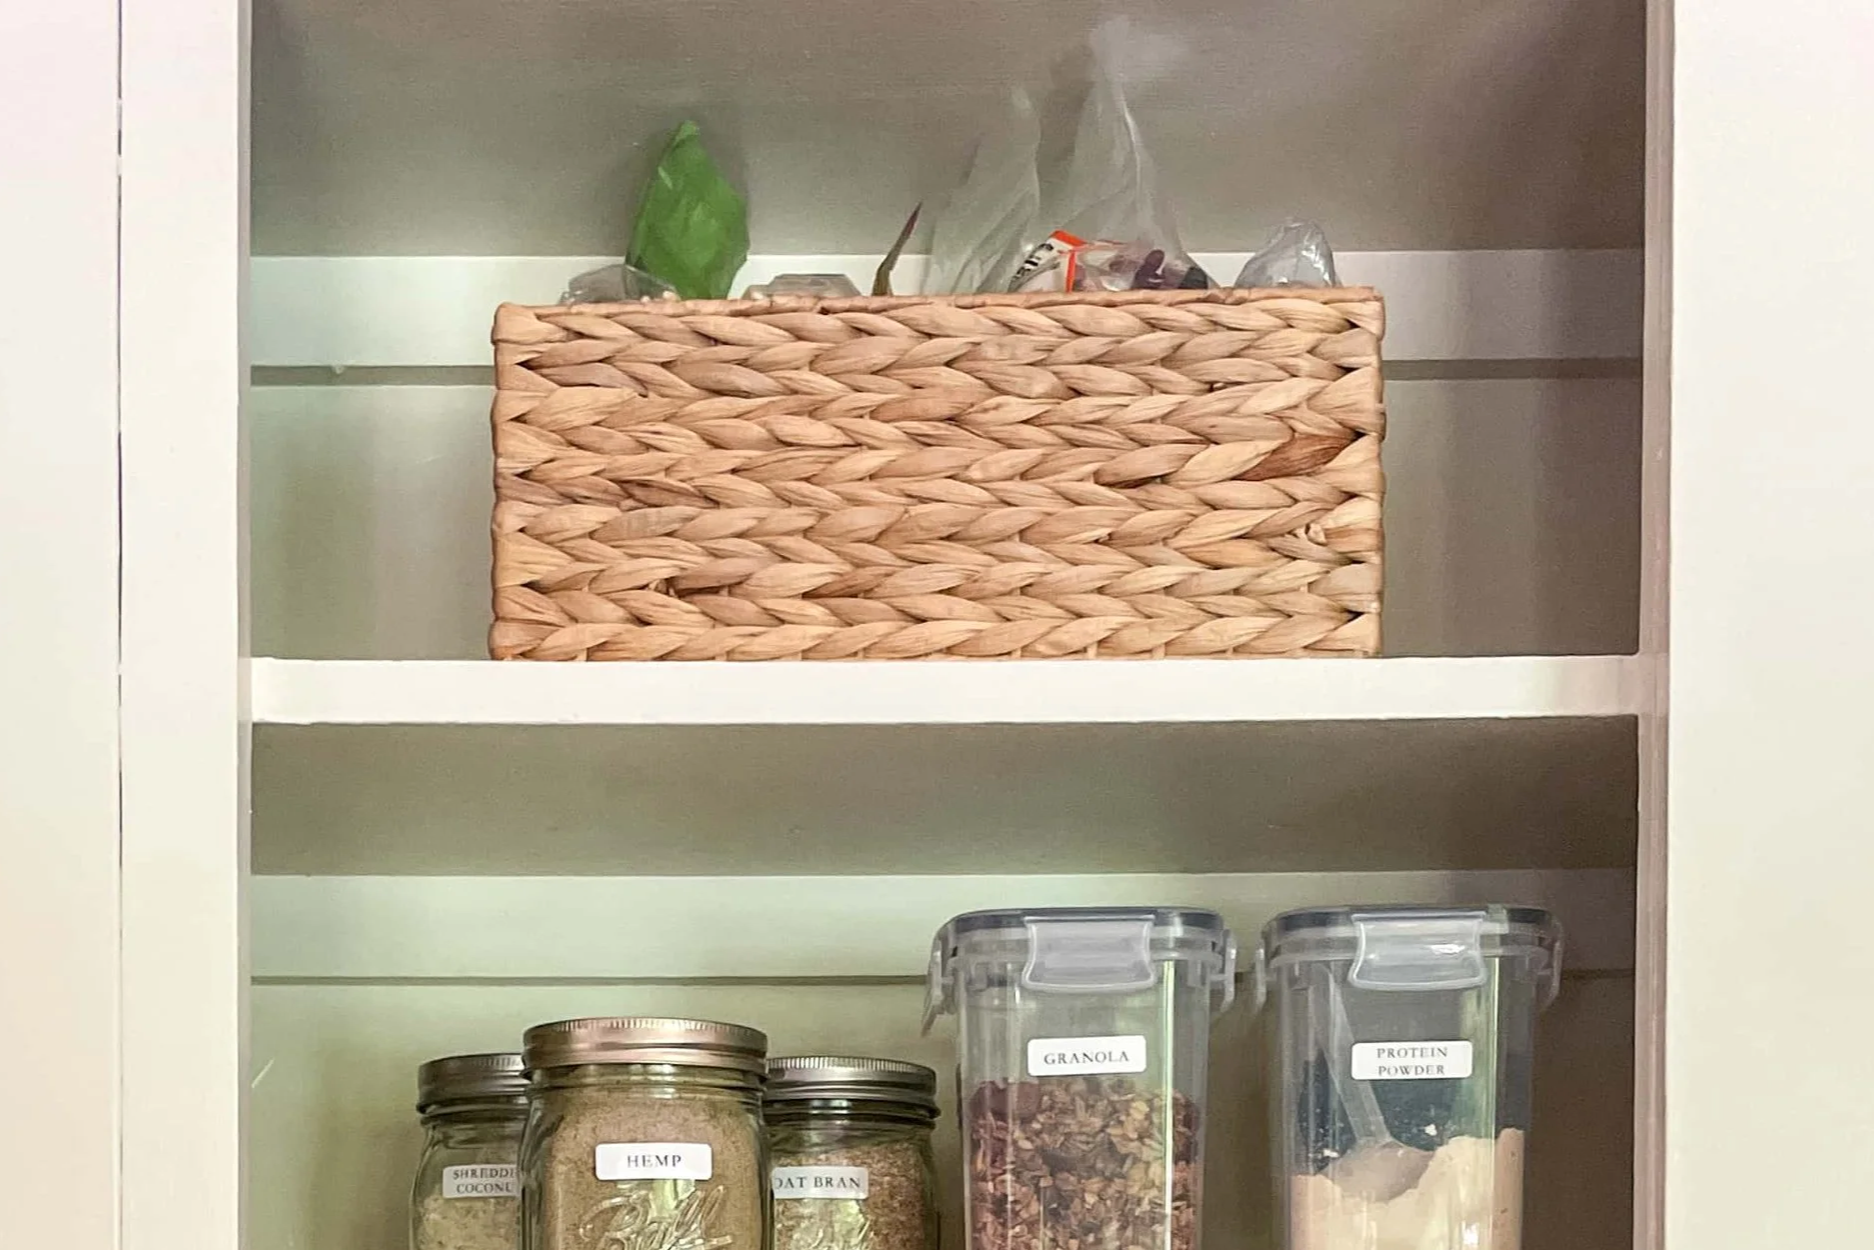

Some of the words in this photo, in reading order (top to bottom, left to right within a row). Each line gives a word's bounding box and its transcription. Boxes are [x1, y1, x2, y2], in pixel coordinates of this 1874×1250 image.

[1043, 1050, 1130, 1066] GRANOLA
[1376, 1046, 1449, 1060] PROTEIN
[1377, 1064, 1446, 1077] POWDER
[627, 1154, 682, 1168] HEMP
[813, 1176, 861, 1189] BRAN
